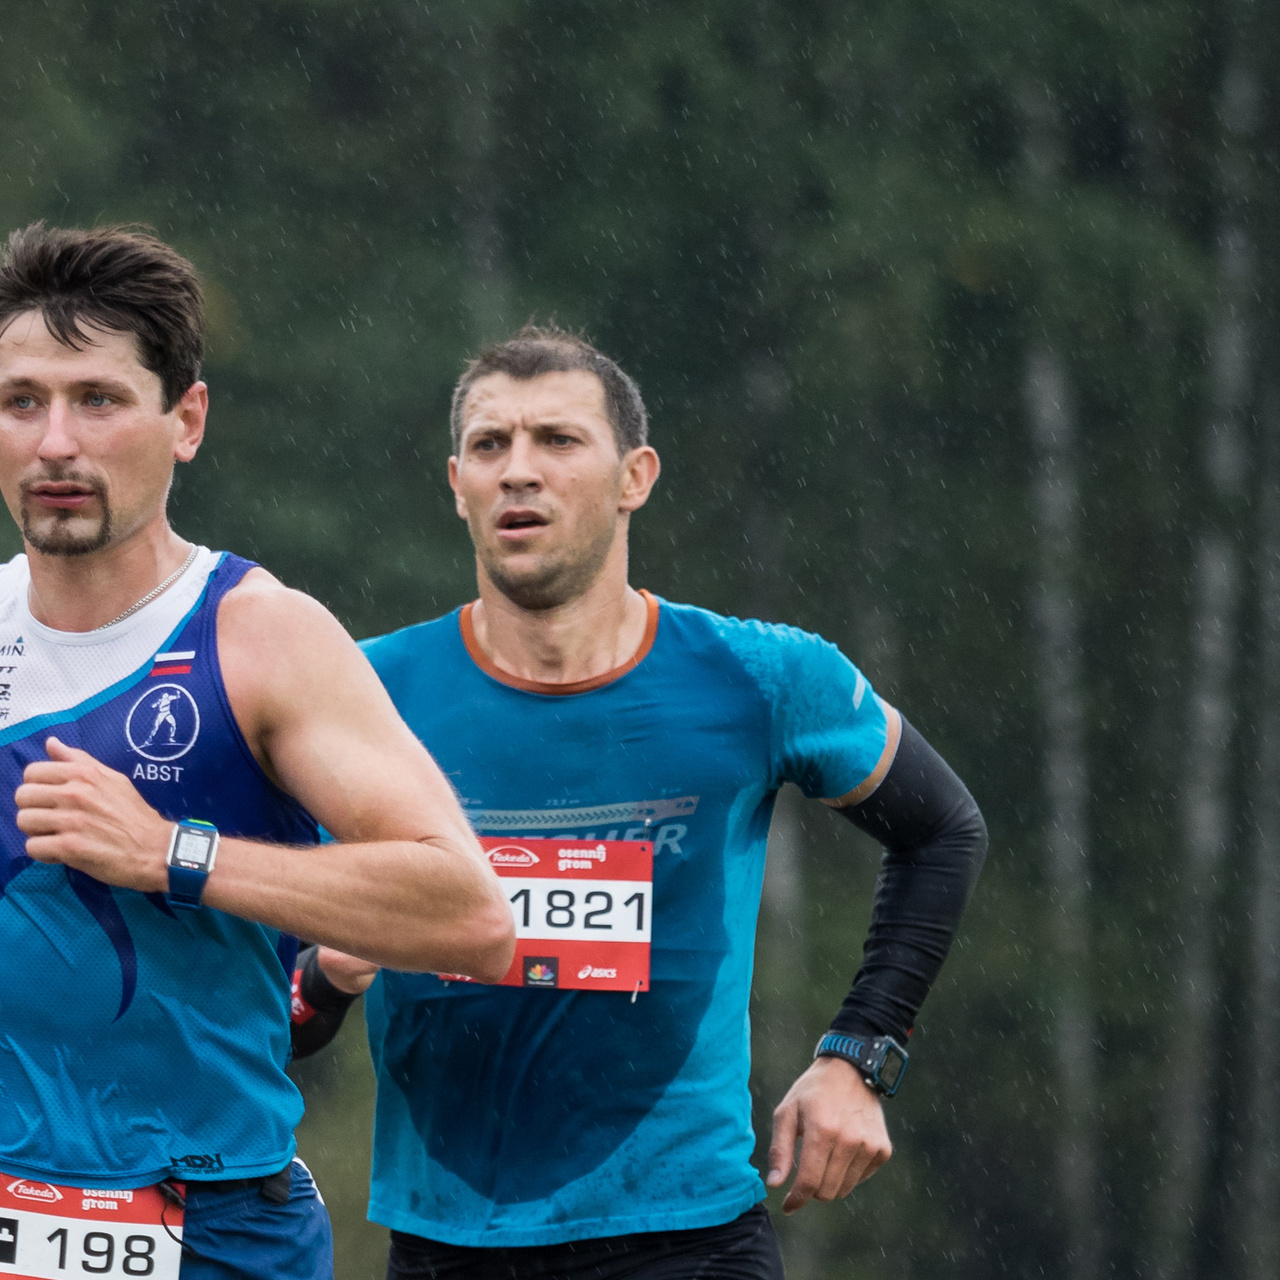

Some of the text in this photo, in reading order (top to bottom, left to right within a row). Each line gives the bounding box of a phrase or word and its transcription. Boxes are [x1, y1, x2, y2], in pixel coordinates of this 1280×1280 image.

[132, 764, 184, 783] ABST
[558, 858, 593, 872] grom
[509, 888, 645, 931] 1821
[17, 1184, 55, 1199] Takeda
[81, 1198, 119, 1211] grom
[46, 1227, 157, 1277] 198
